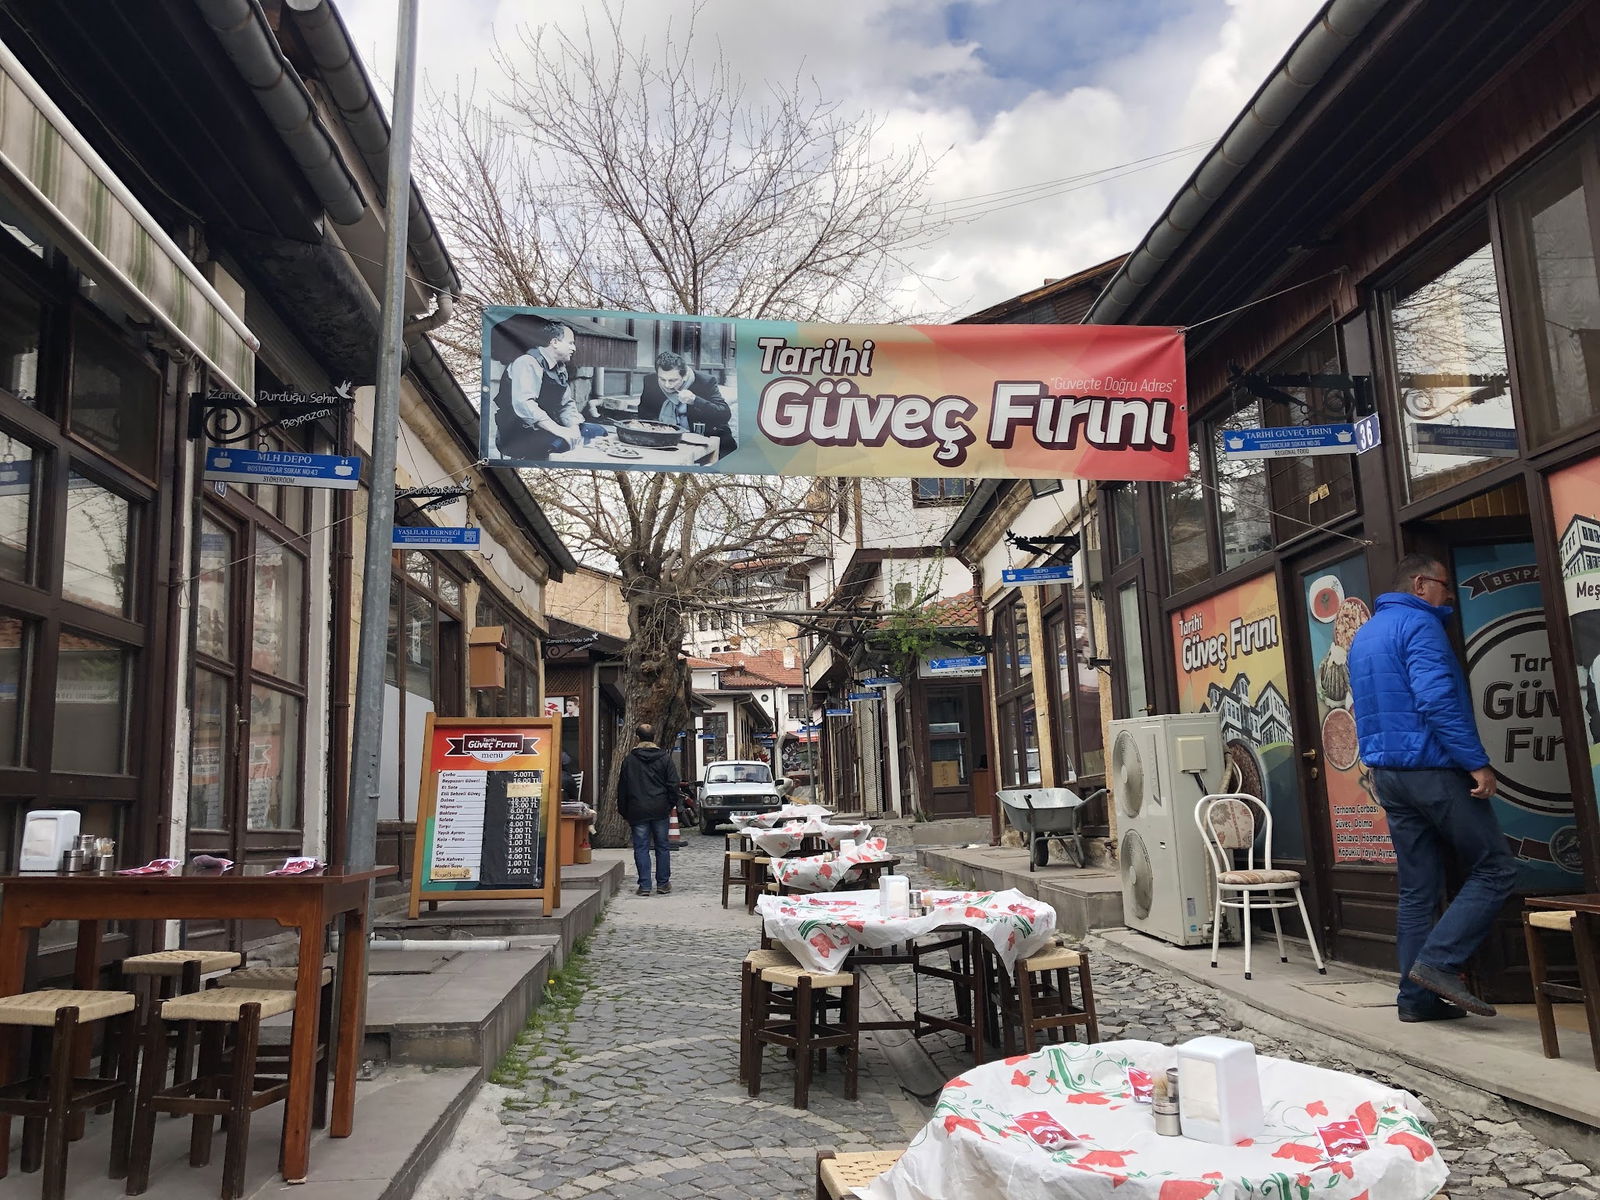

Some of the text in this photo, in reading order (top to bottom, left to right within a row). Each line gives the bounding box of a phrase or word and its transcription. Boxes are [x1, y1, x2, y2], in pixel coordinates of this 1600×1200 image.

[758, 337, 874, 376] Tarihi
[1050, 376, 1177, 394] "Güveçte Doğru Adres"
[259, 390, 306, 405] Durduğu
[758, 377, 1176, 467] Güveç Fırını
[1276, 428, 1305, 438] GÜVEÇ
[1306, 427, 1332, 436] FIRINI
[1359, 421, 1373, 450] 36
[257, 453, 312, 465] MLH DEPO
[398, 528, 461, 537] YAŞLILAR DERNEĞİ
[1178, 612, 1203, 637] Tarihi
[1182, 614, 1279, 673] Güveç Fırını
[1510, 653, 1552, 673] Tar
[467, 740, 519, 751] Güveç Fırını
